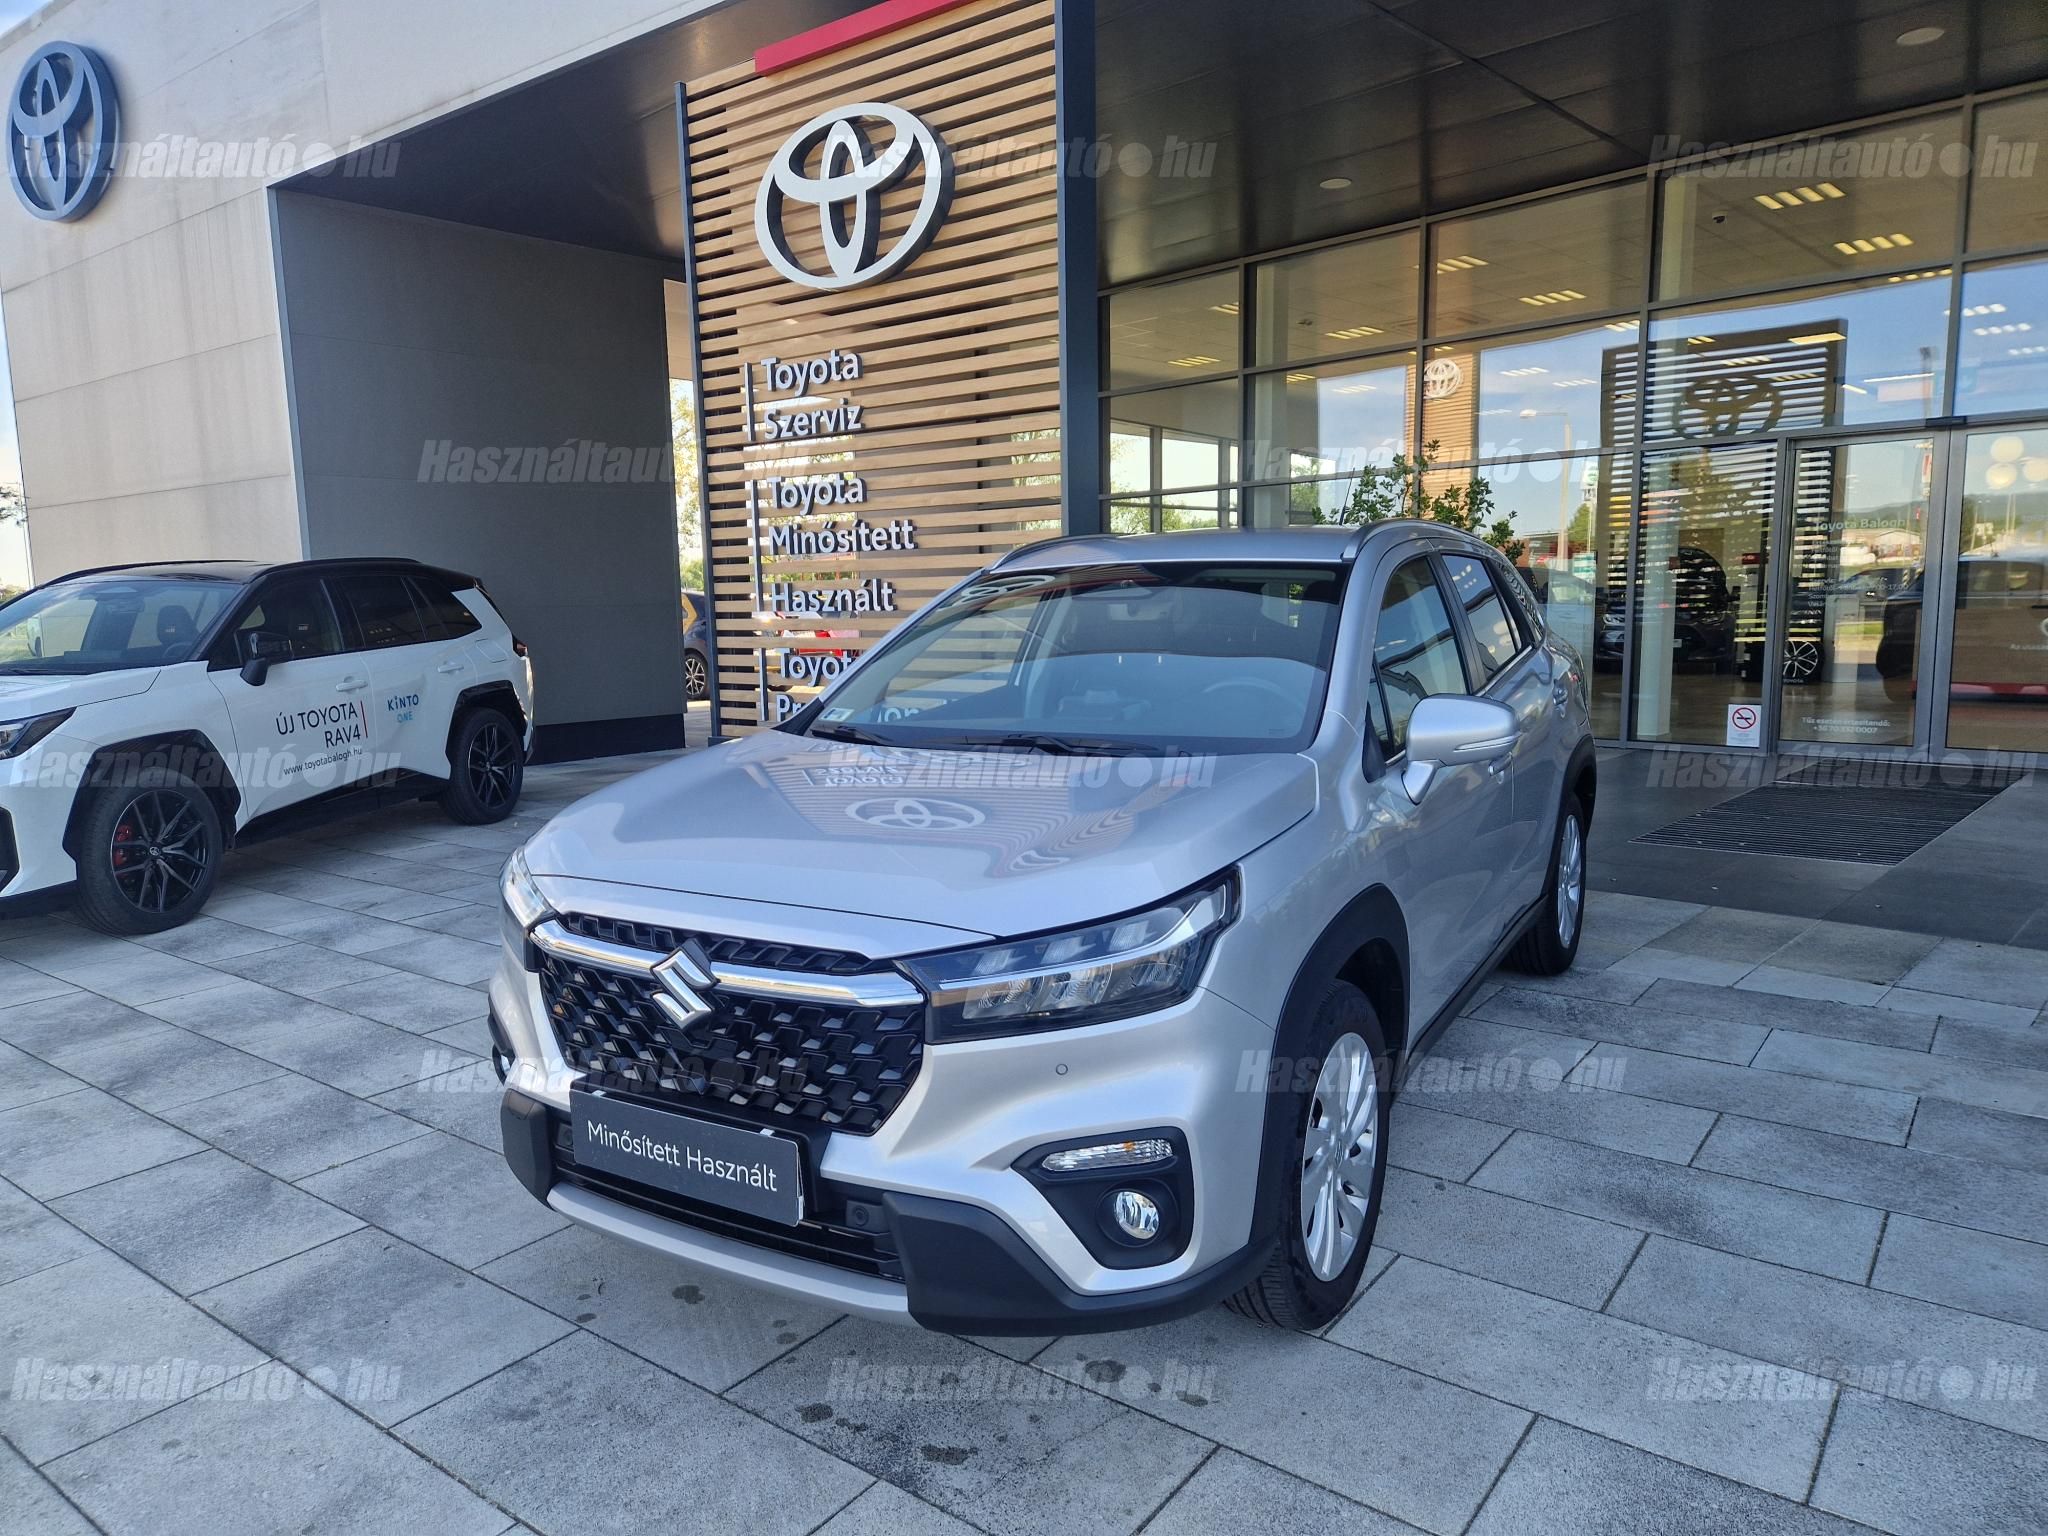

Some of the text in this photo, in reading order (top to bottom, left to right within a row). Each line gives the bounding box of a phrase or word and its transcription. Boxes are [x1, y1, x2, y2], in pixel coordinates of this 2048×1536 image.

[761, 349, 863, 396] Toyota
[764, 398, 864, 440] Szerviz
[767, 473, 866, 516] Toyota
[768, 519, 917, 556] Minősített
[770, 578, 896, 613] Használt
[775, 648, 853, 687] Toyot
[275, 702, 358, 735] ÚJ TOYOTA
[324, 723, 361, 748] RAV4
[587, 1119, 778, 1192] Minősített Használt
